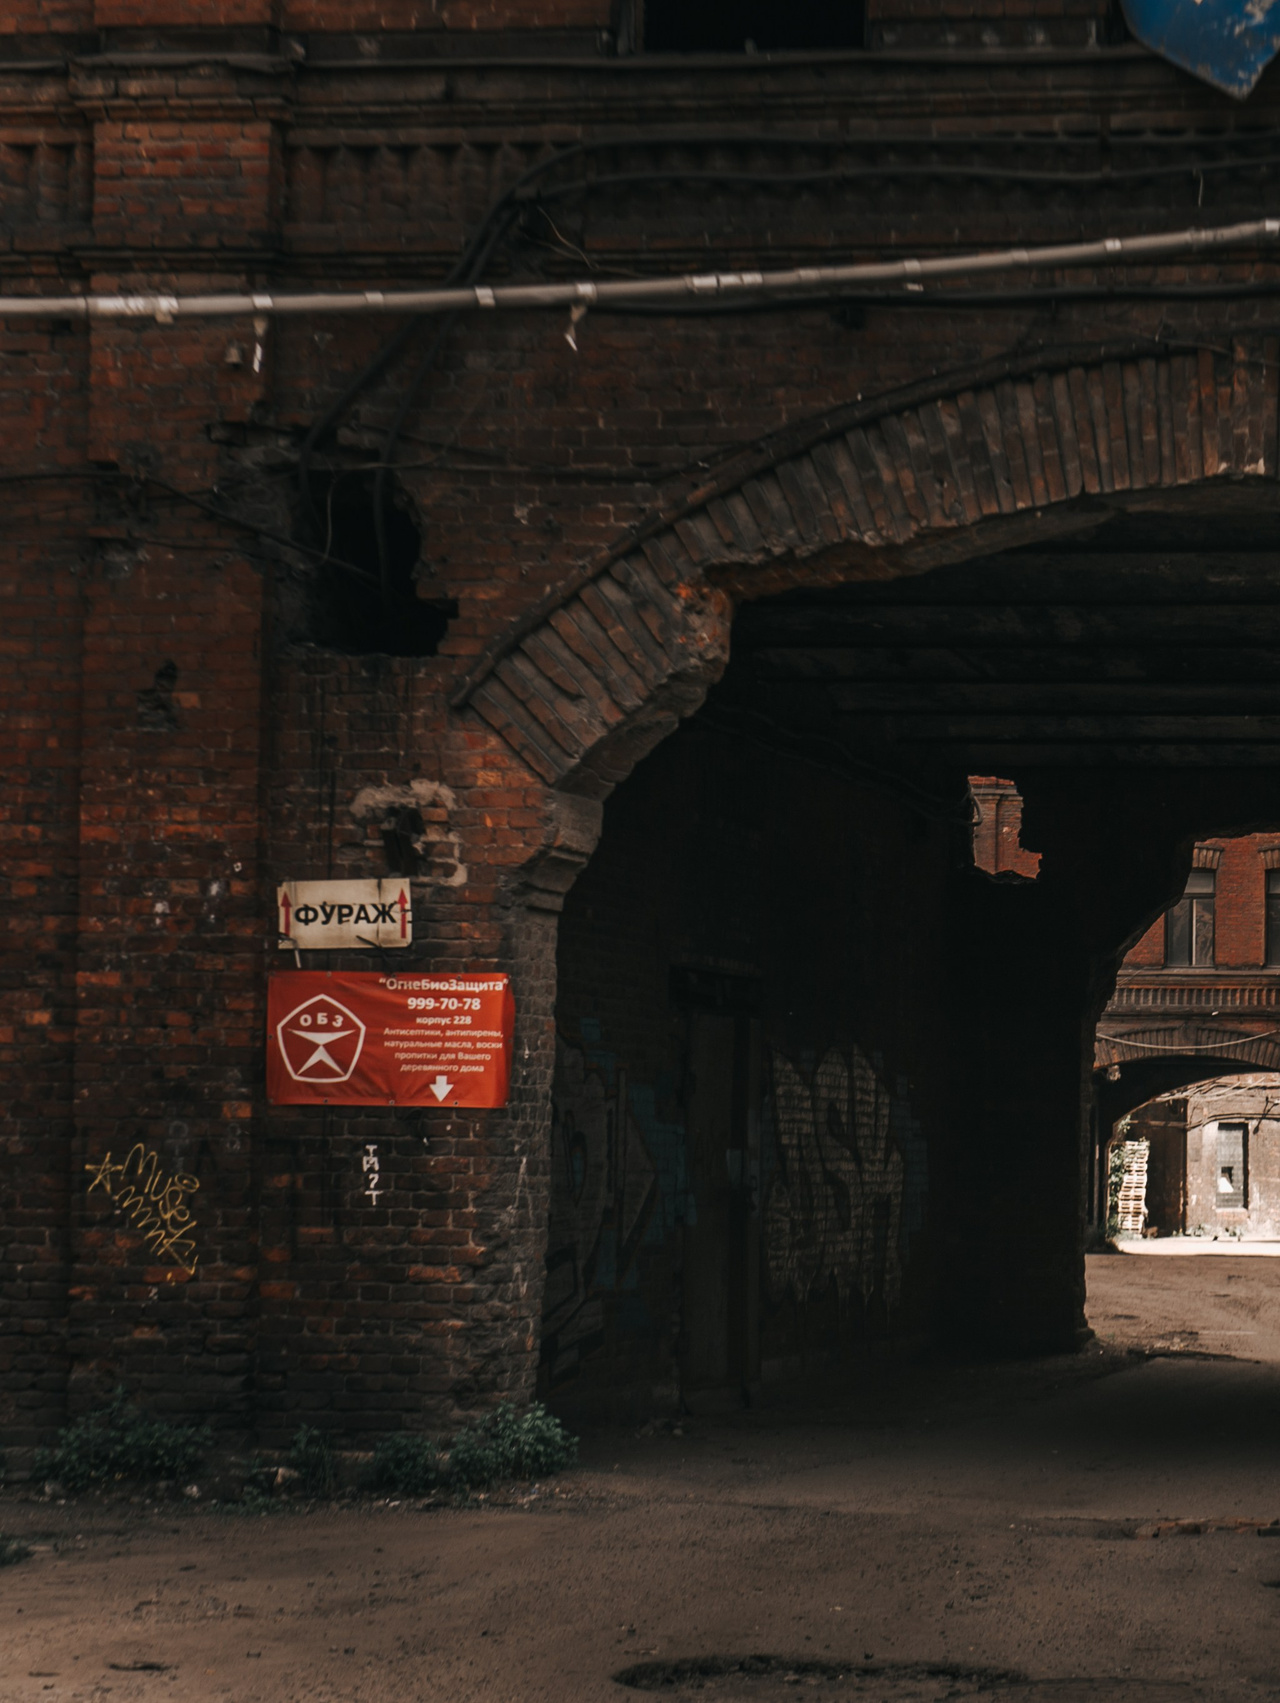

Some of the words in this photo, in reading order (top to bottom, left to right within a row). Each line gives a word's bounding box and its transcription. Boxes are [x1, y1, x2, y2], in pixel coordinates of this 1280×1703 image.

[294, 902, 398, 926] ФУРАЖ
[407, 997, 481, 1010] 999-70-78
[416, 1016, 452, 1026] корпус
[453, 1015, 472, 1025] 228
[383, 1027, 444, 1037] Антисептики,
[445, 1029, 504, 1039] антипирены,
[384, 1040, 443, 1050] натуральные
[444, 1041, 475, 1050] масла,
[394, 1052, 438, 1062] пропитки
[438, 1052, 456, 1061] для
[457, 1052, 492, 1061] Вашего
[400, 1063, 459, 1074] деревянного
[460, 1063, 485, 1074] дома
